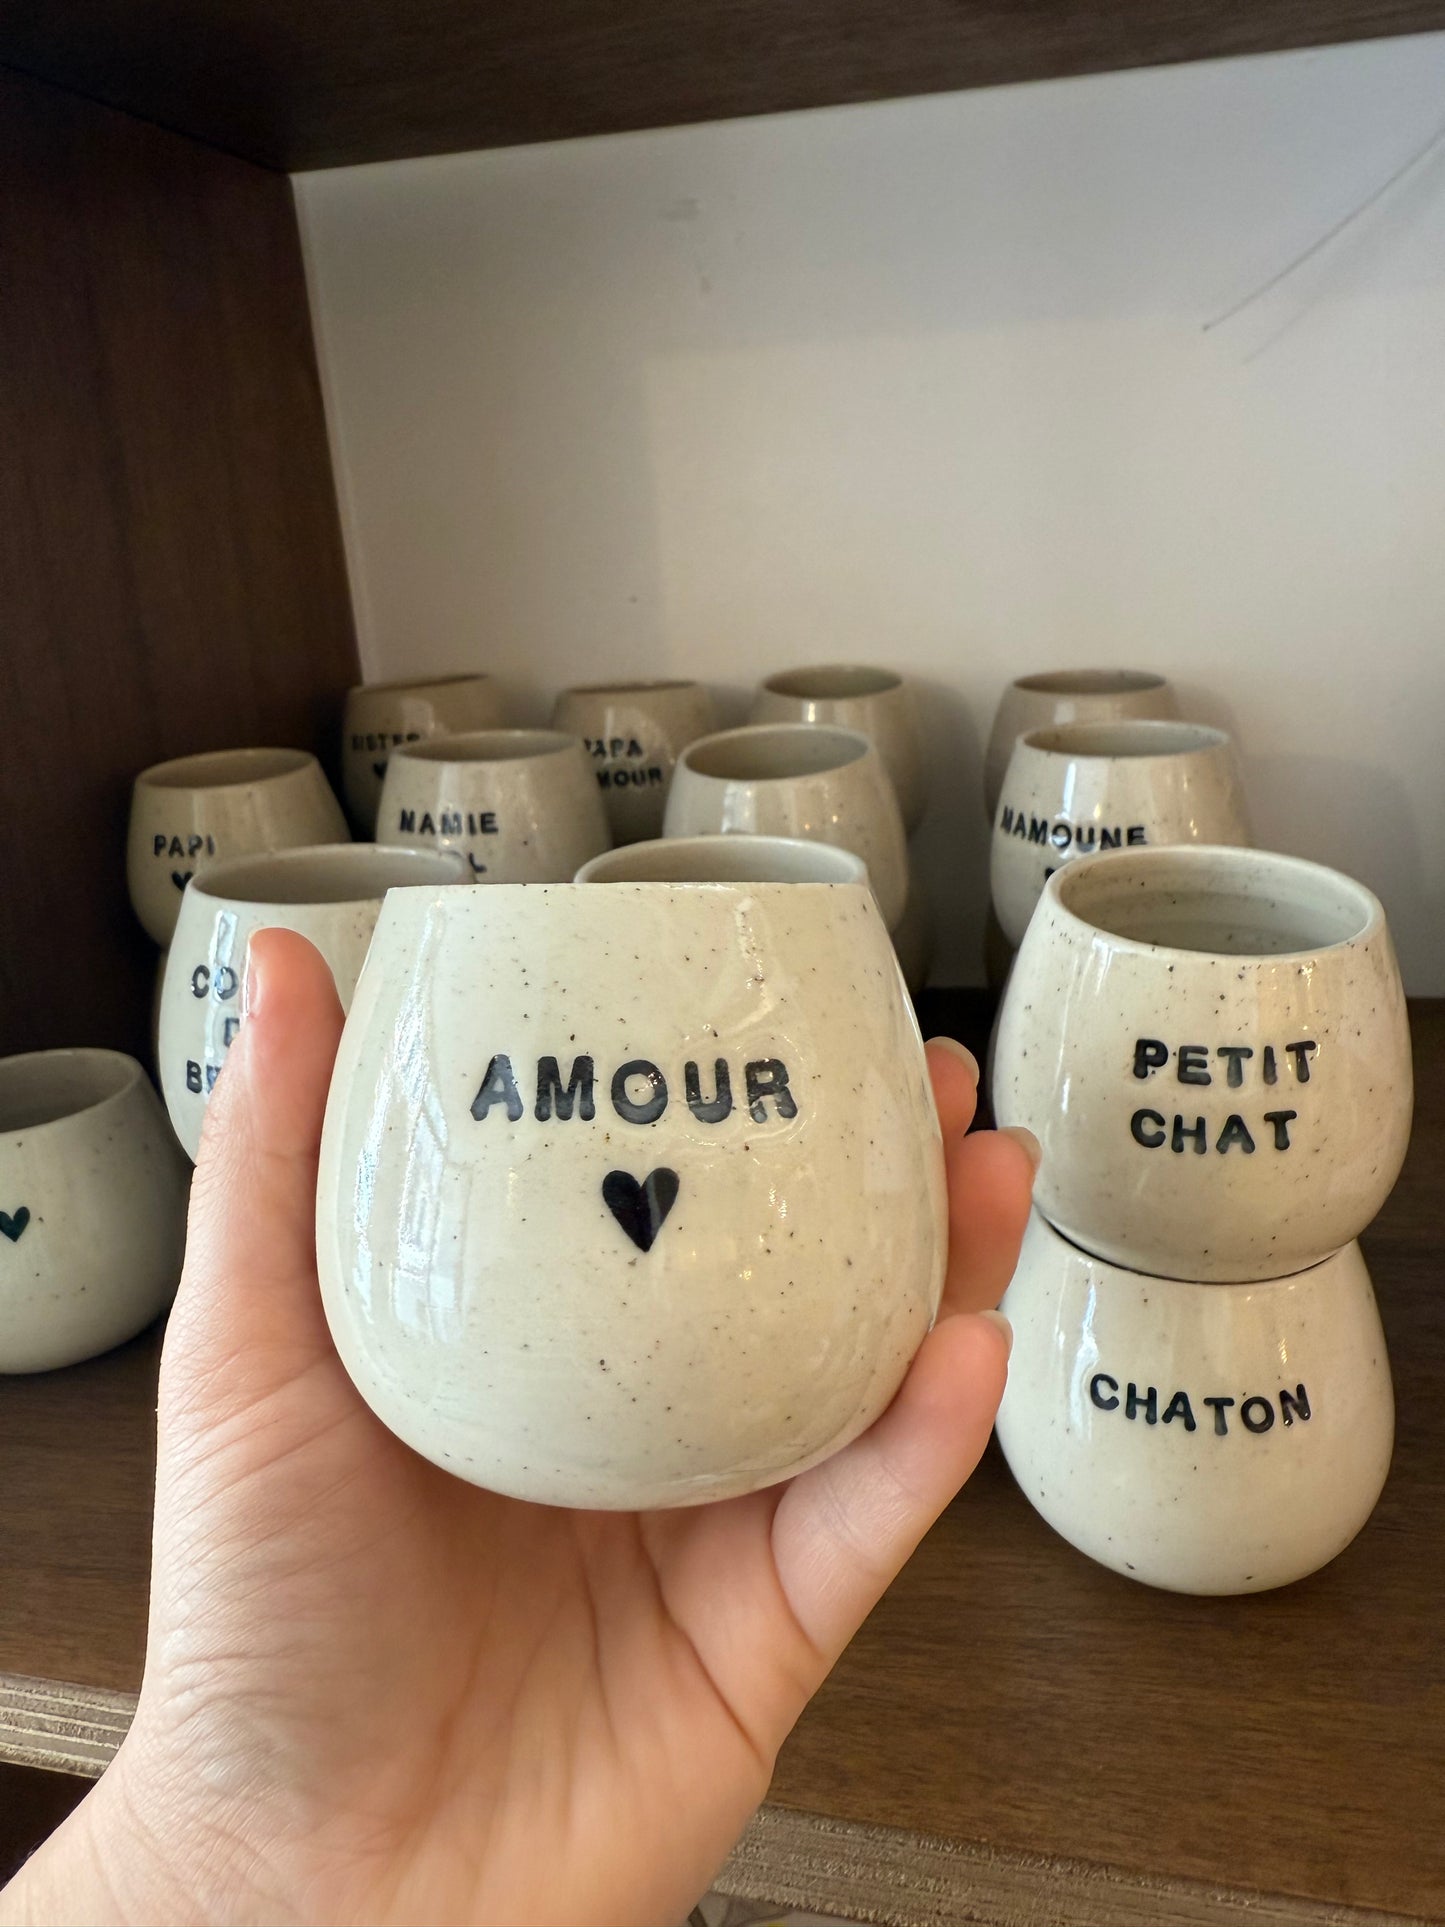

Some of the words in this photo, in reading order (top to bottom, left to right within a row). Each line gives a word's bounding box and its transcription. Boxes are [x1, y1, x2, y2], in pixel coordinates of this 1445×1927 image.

[596, 767, 662, 789] MOUR
[399, 808, 499, 836] MAMIE
[1000, 805, 1149, 852] MAMOUNE
[153, 834, 216, 857] PAPI
[1132, 1038, 1317, 1088] PETIT
[470, 1053, 799, 1124] AMOUR
[1130, 1108, 1298, 1154] CHAT
[1089, 1373, 1312, 1436] CHATON
